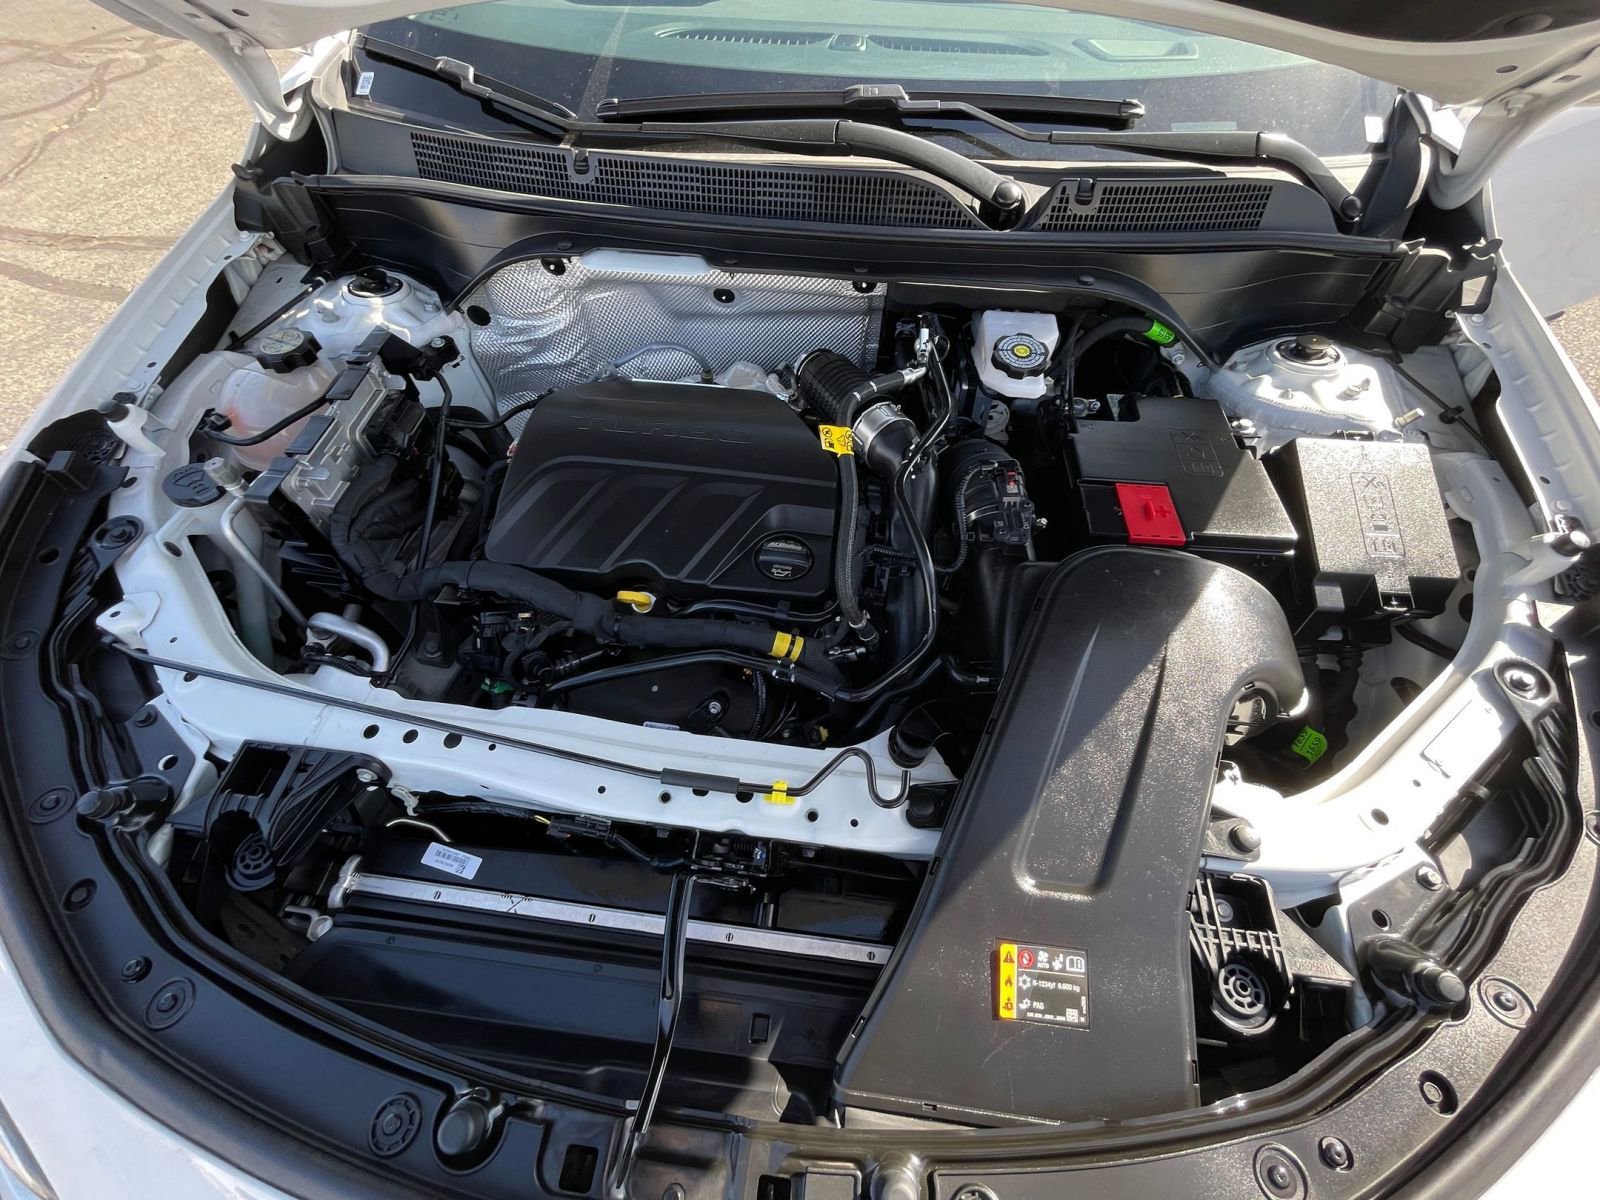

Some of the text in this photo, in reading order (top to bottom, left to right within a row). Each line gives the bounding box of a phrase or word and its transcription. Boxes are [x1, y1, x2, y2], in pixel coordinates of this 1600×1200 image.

[570, 412, 755, 444] TURBO
[1073, 984, 1081, 993] kg
[1032, 1000, 1045, 1010] PAG
